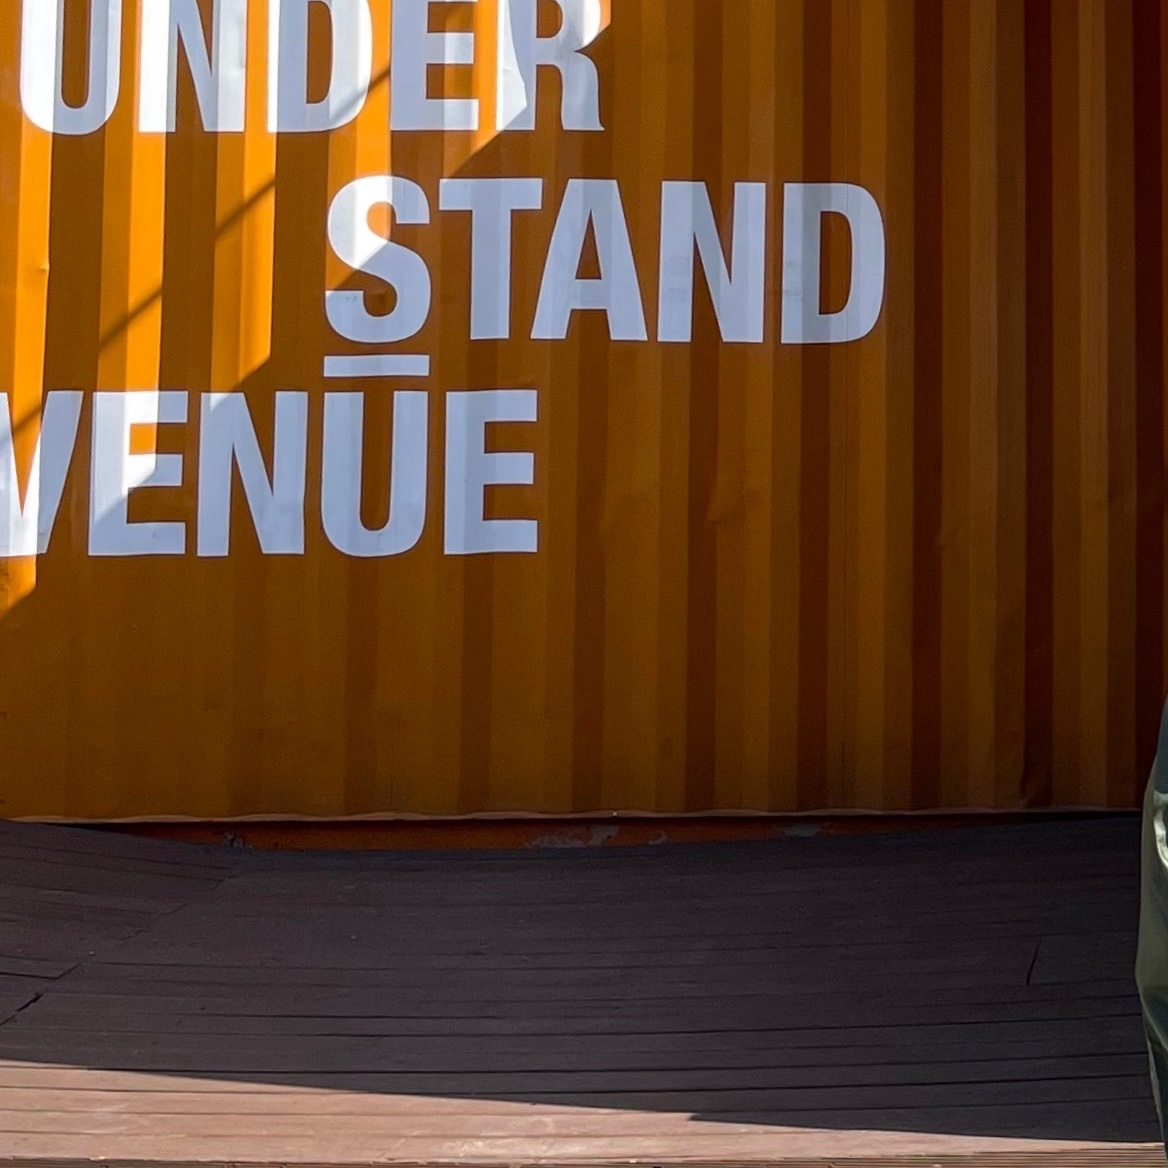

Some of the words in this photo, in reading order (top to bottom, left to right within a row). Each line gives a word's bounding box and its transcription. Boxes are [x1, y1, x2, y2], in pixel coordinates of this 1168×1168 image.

[19, 0, 605, 135] UNDER
[325, 175, 886, 344] STAND
[0, 388, 539, 557] VENUE
